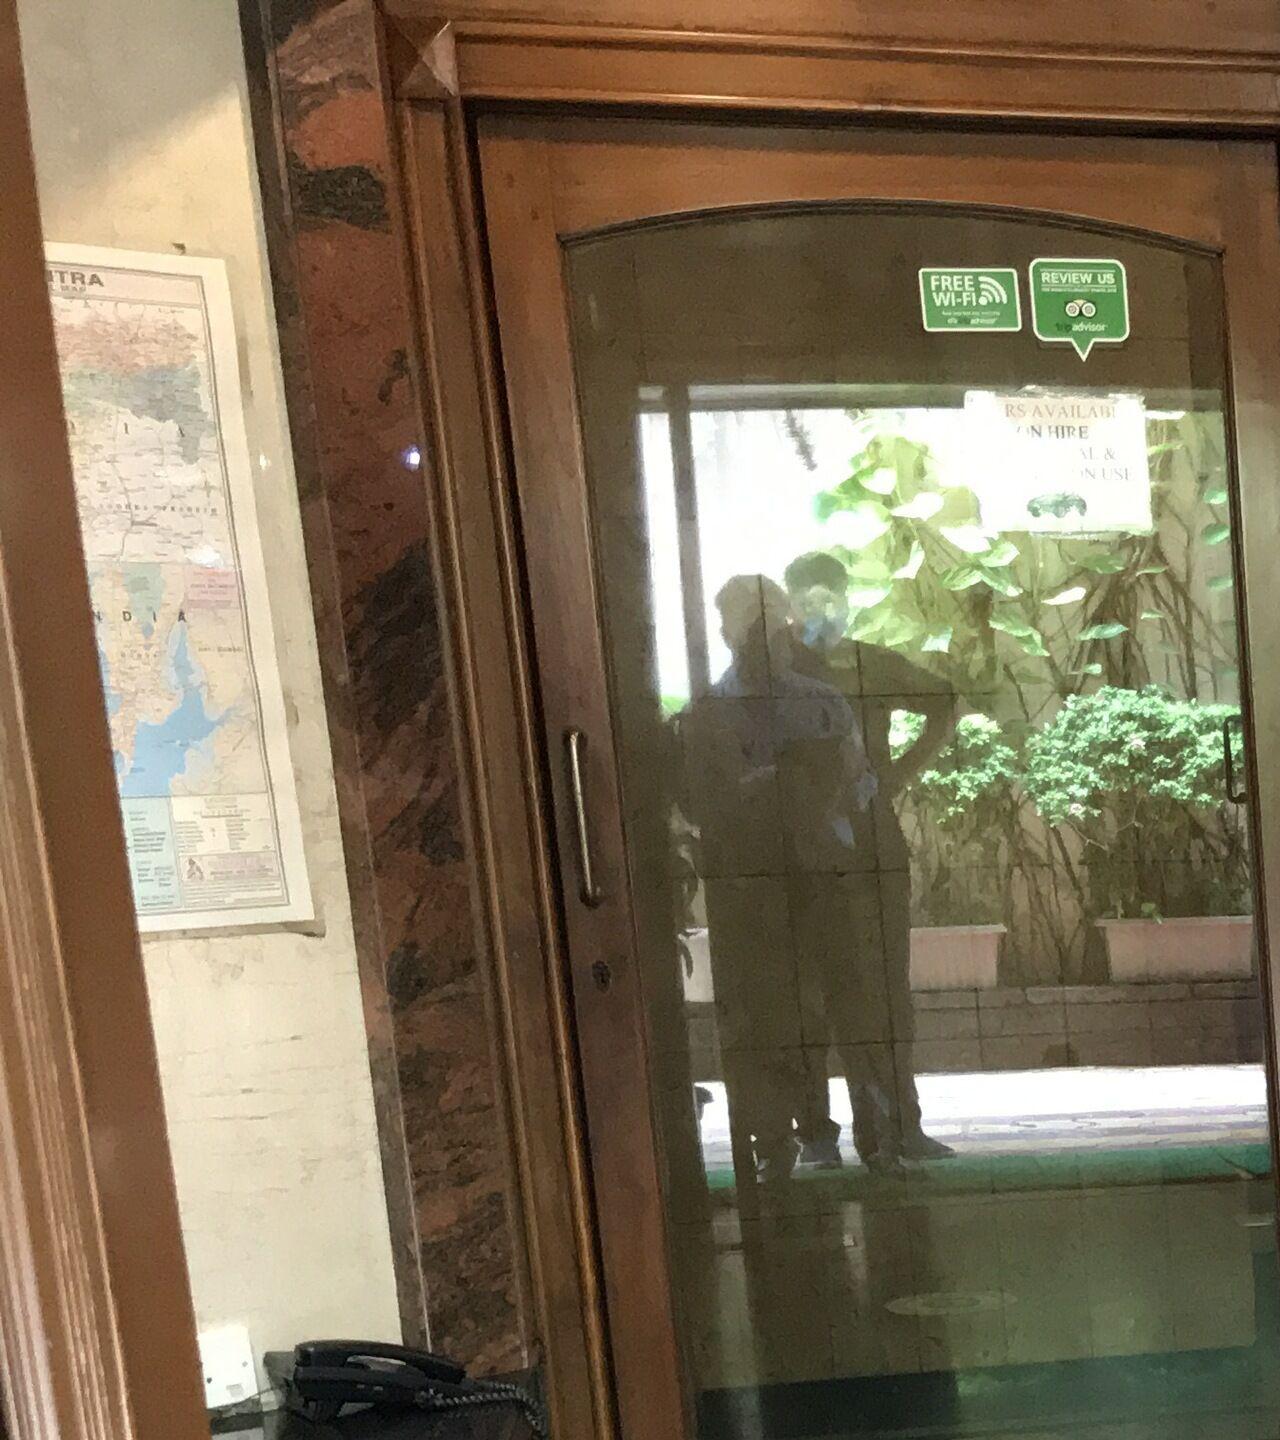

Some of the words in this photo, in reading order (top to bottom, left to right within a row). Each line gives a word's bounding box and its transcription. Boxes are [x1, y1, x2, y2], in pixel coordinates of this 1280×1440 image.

[47, 269, 104, 287] TRA
[930, 275, 975, 292] FREE
[1041, 271, 1092, 284] REVIEW
[1097, 273, 1115, 285] US
[932, 292, 977, 307] WI-FI
